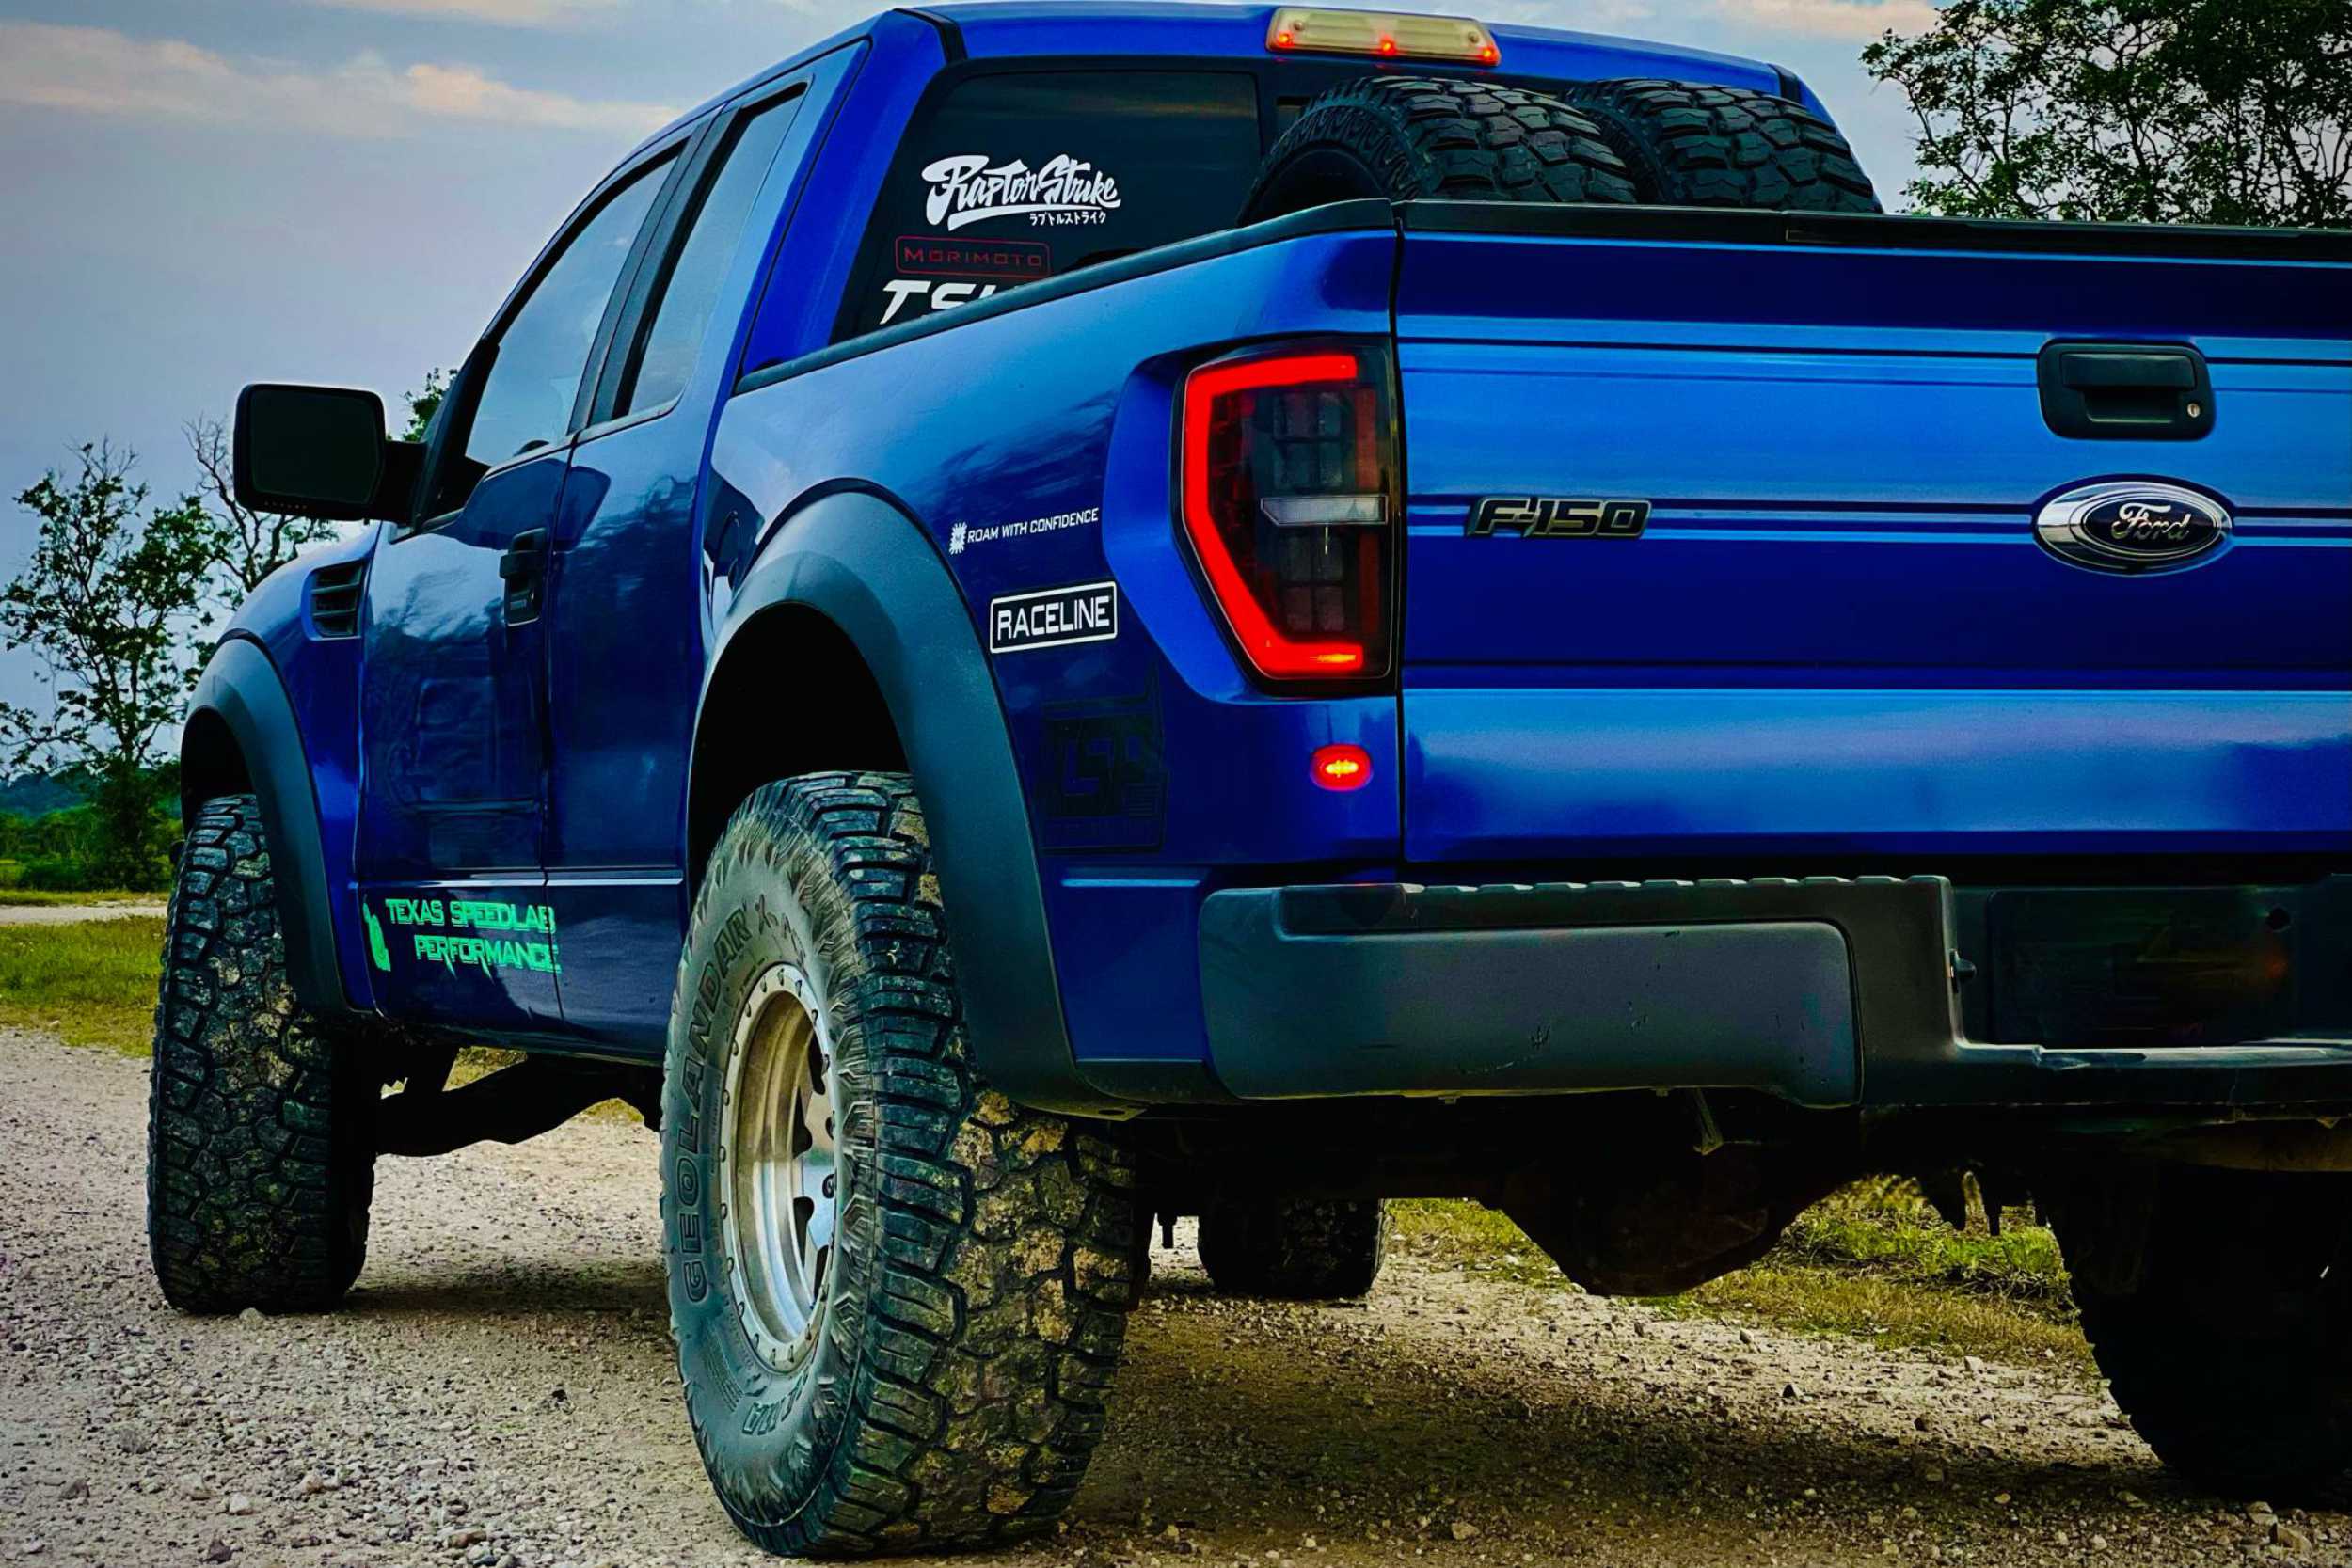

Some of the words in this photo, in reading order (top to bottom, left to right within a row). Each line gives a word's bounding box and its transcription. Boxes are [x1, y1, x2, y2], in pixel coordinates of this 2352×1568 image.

[903, 246, 1043, 267] MORIMOTO
[966, 525, 999, 544] ROAM
[1001, 521, 1027, 539] WITH
[1029, 507, 1100, 533] CONFIDENCE
[1468, 496, 1652, 537] F-150
[2110, 502, 2192, 541] Ford
[996, 594, 1111, 641] RACELINE
[385, 898, 445, 926] TEXAS
[450, 900, 556, 933] SPEEDLAB
[414, 934, 562, 985] PERFORMANCE
[676, 907, 753, 1303] GEOLANDAR
